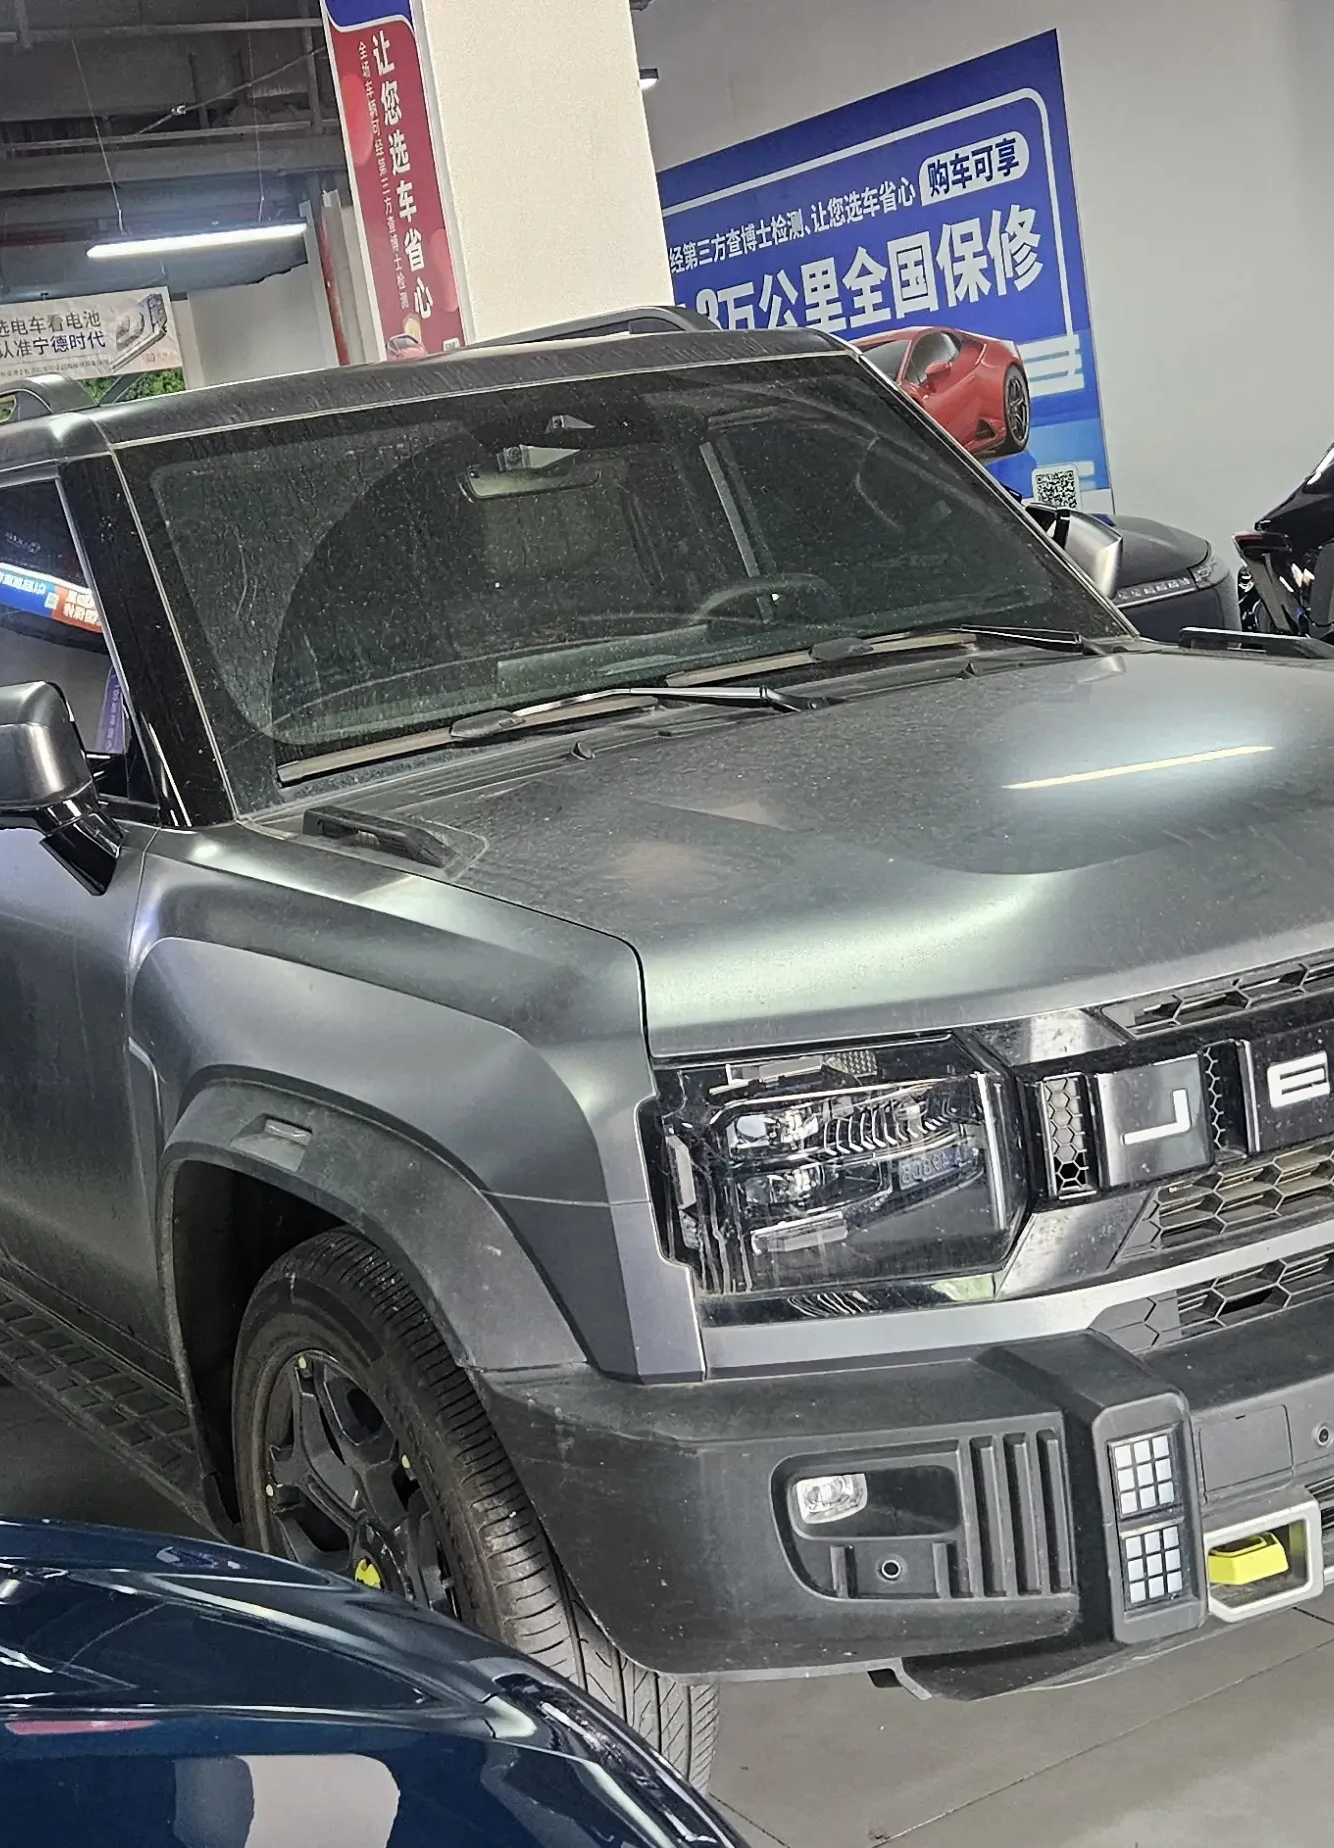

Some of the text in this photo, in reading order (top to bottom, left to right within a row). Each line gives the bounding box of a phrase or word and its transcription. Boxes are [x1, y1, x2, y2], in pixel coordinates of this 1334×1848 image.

[372, 30, 434, 319] 让您选车省心
[928, 139, 1019, 195] 购车可享
